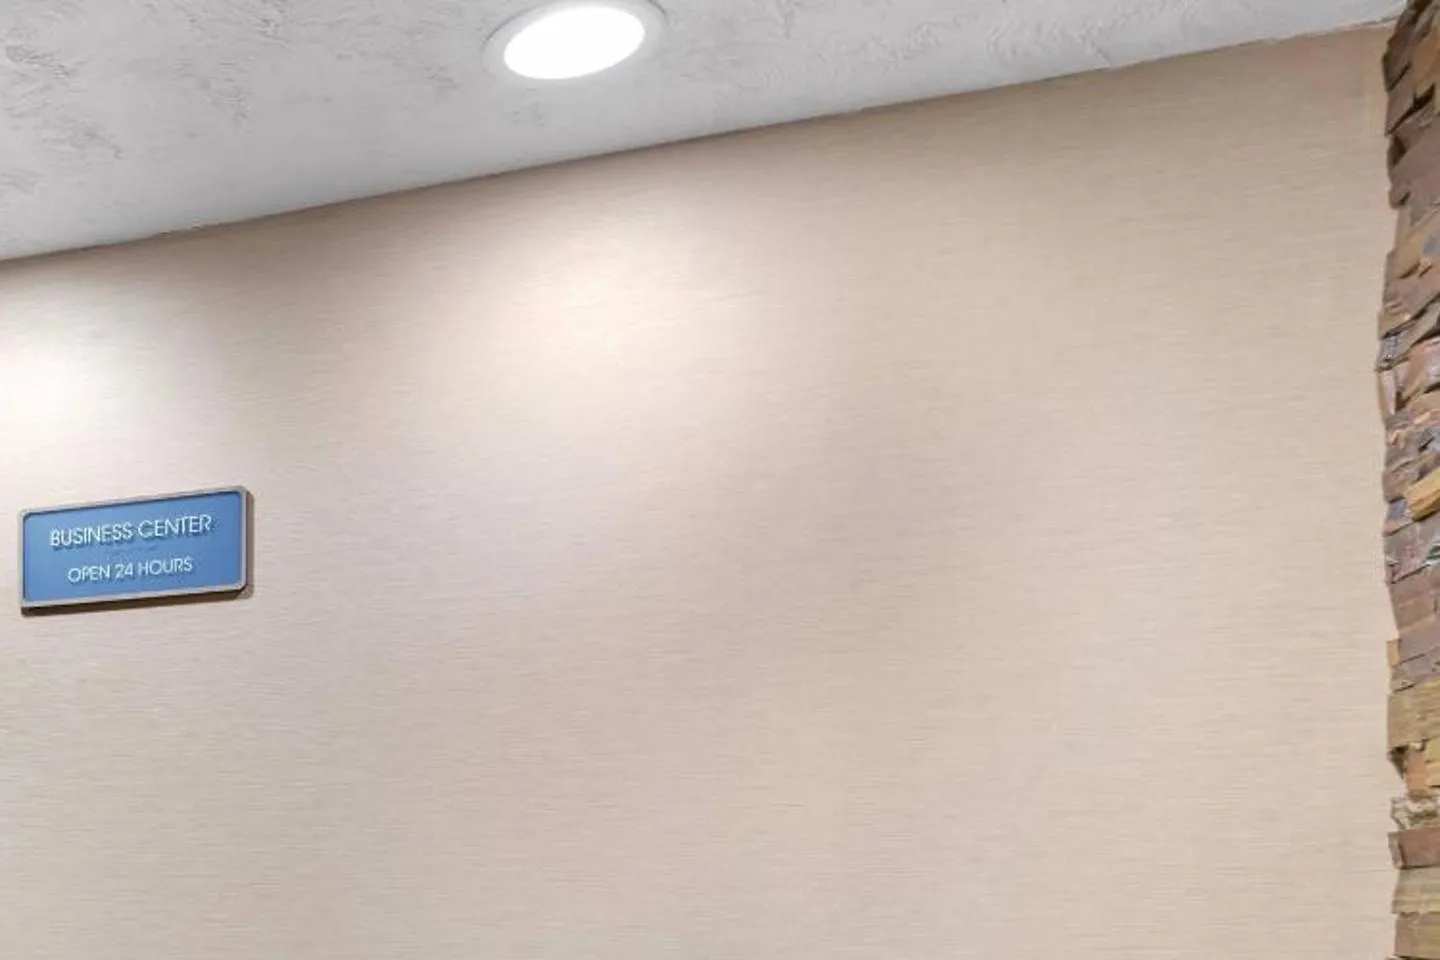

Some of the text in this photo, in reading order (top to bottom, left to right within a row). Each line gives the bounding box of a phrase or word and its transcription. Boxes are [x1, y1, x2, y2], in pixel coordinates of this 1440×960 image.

[50, 513, 212, 547] BUSINESS CENTER
[68, 555, 193, 583] OPEN 24 HOURS
